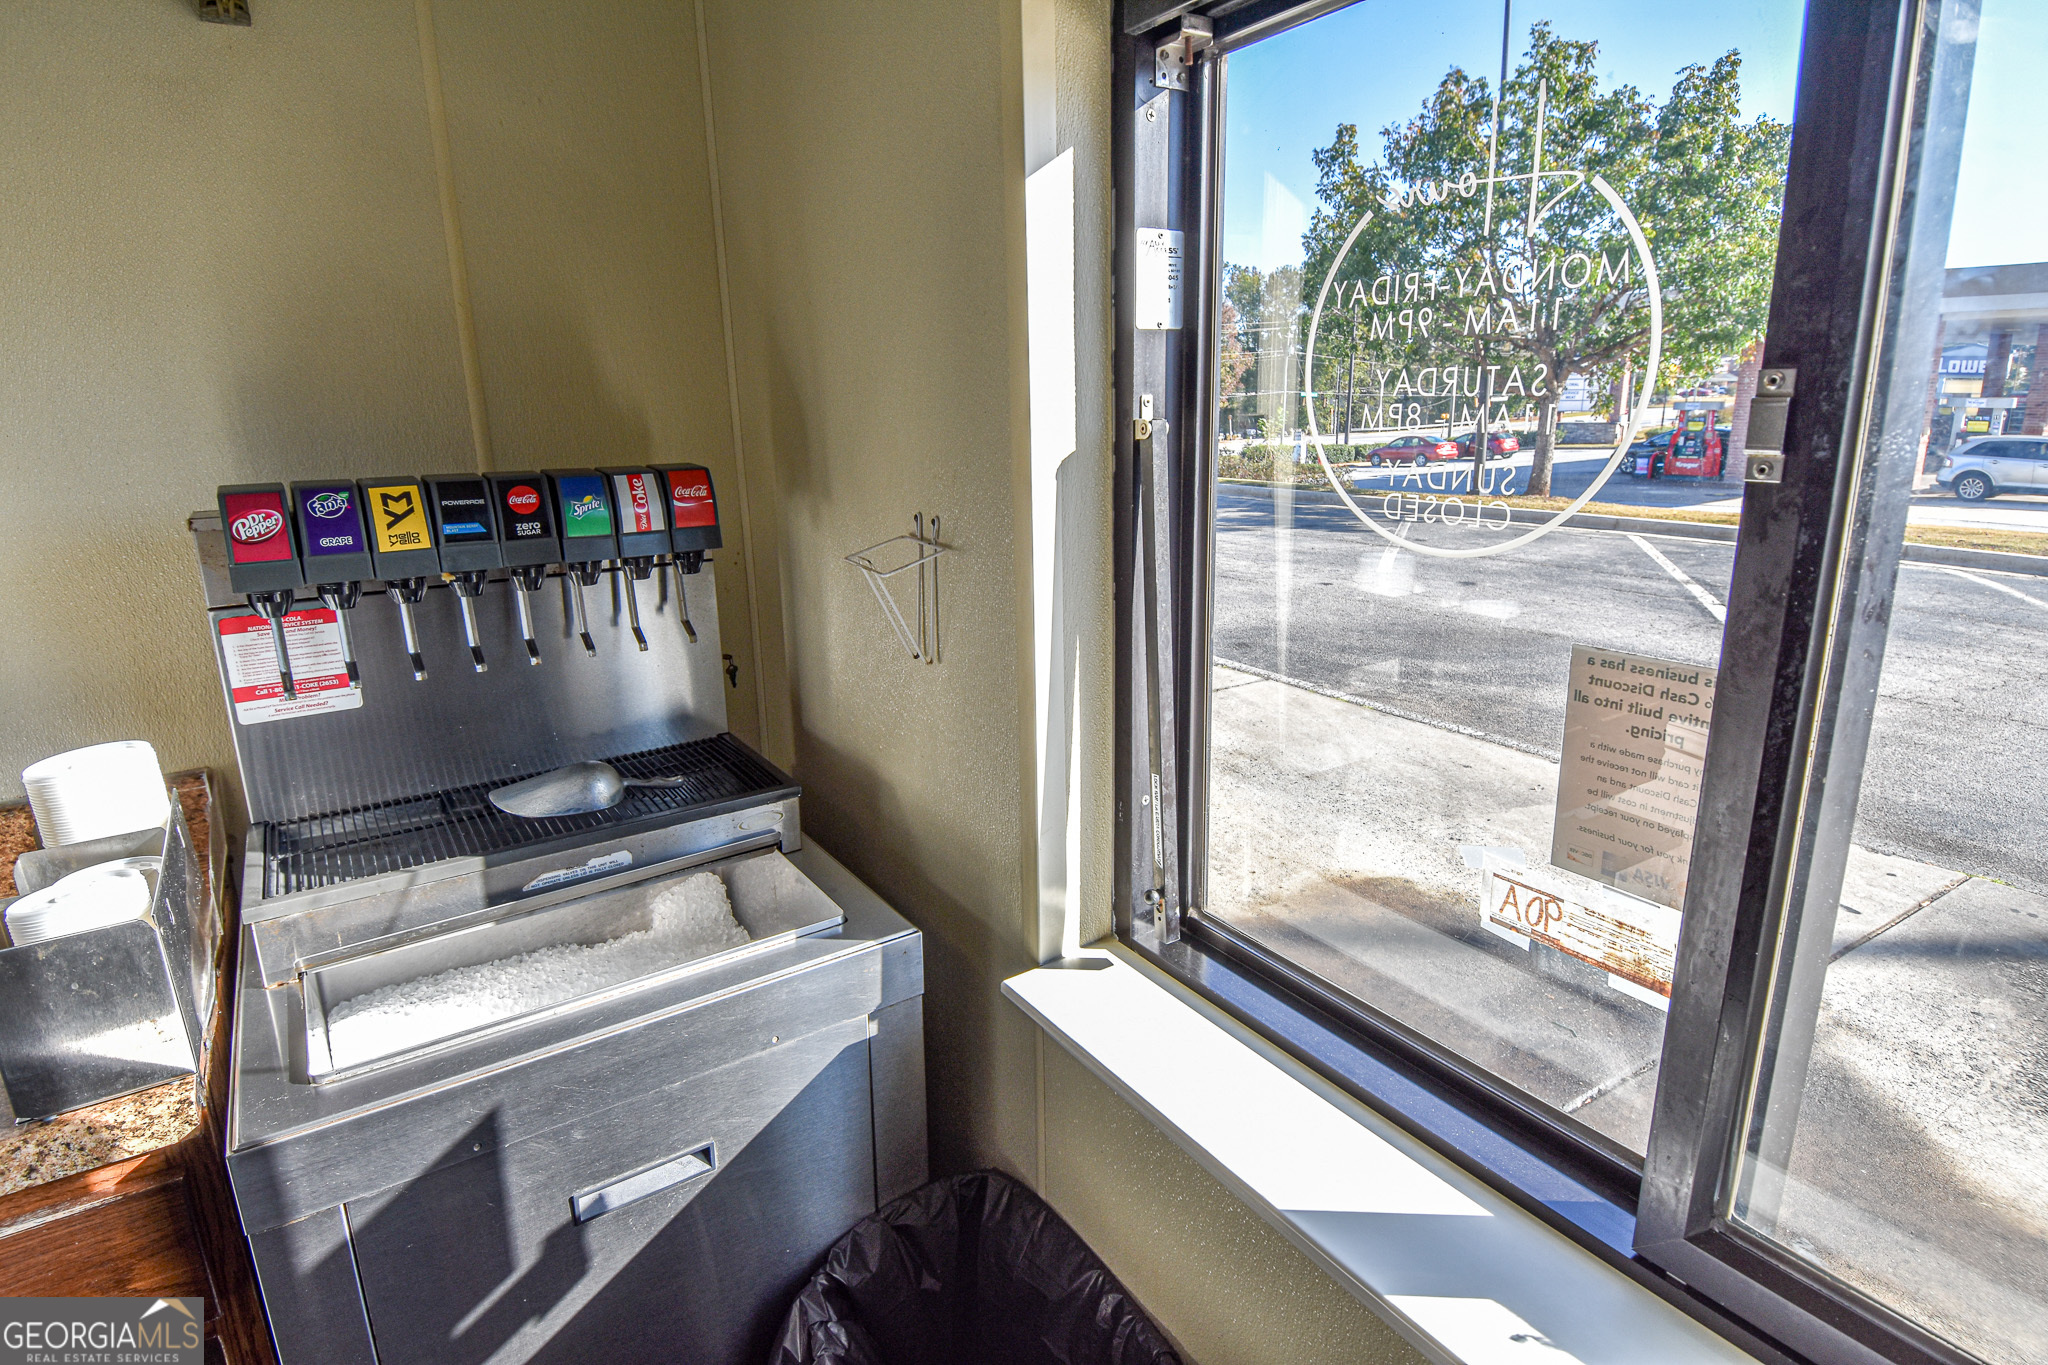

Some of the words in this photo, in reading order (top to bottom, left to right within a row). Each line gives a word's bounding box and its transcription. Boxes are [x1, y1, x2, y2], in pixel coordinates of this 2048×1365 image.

[1939, 358, 1986, 373] LOWE
[632, 478, 648, 513] Coke
[307, 496, 347, 517] Fanta
[574, 499, 600, 516] Sprite
[237, 514, 278, 540] Pepper
[248, 513, 266, 526] Dr
[516, 522, 540, 530] zero
[640, 514, 648, 530] Diet
[320, 536, 353, 547] GRAPE
